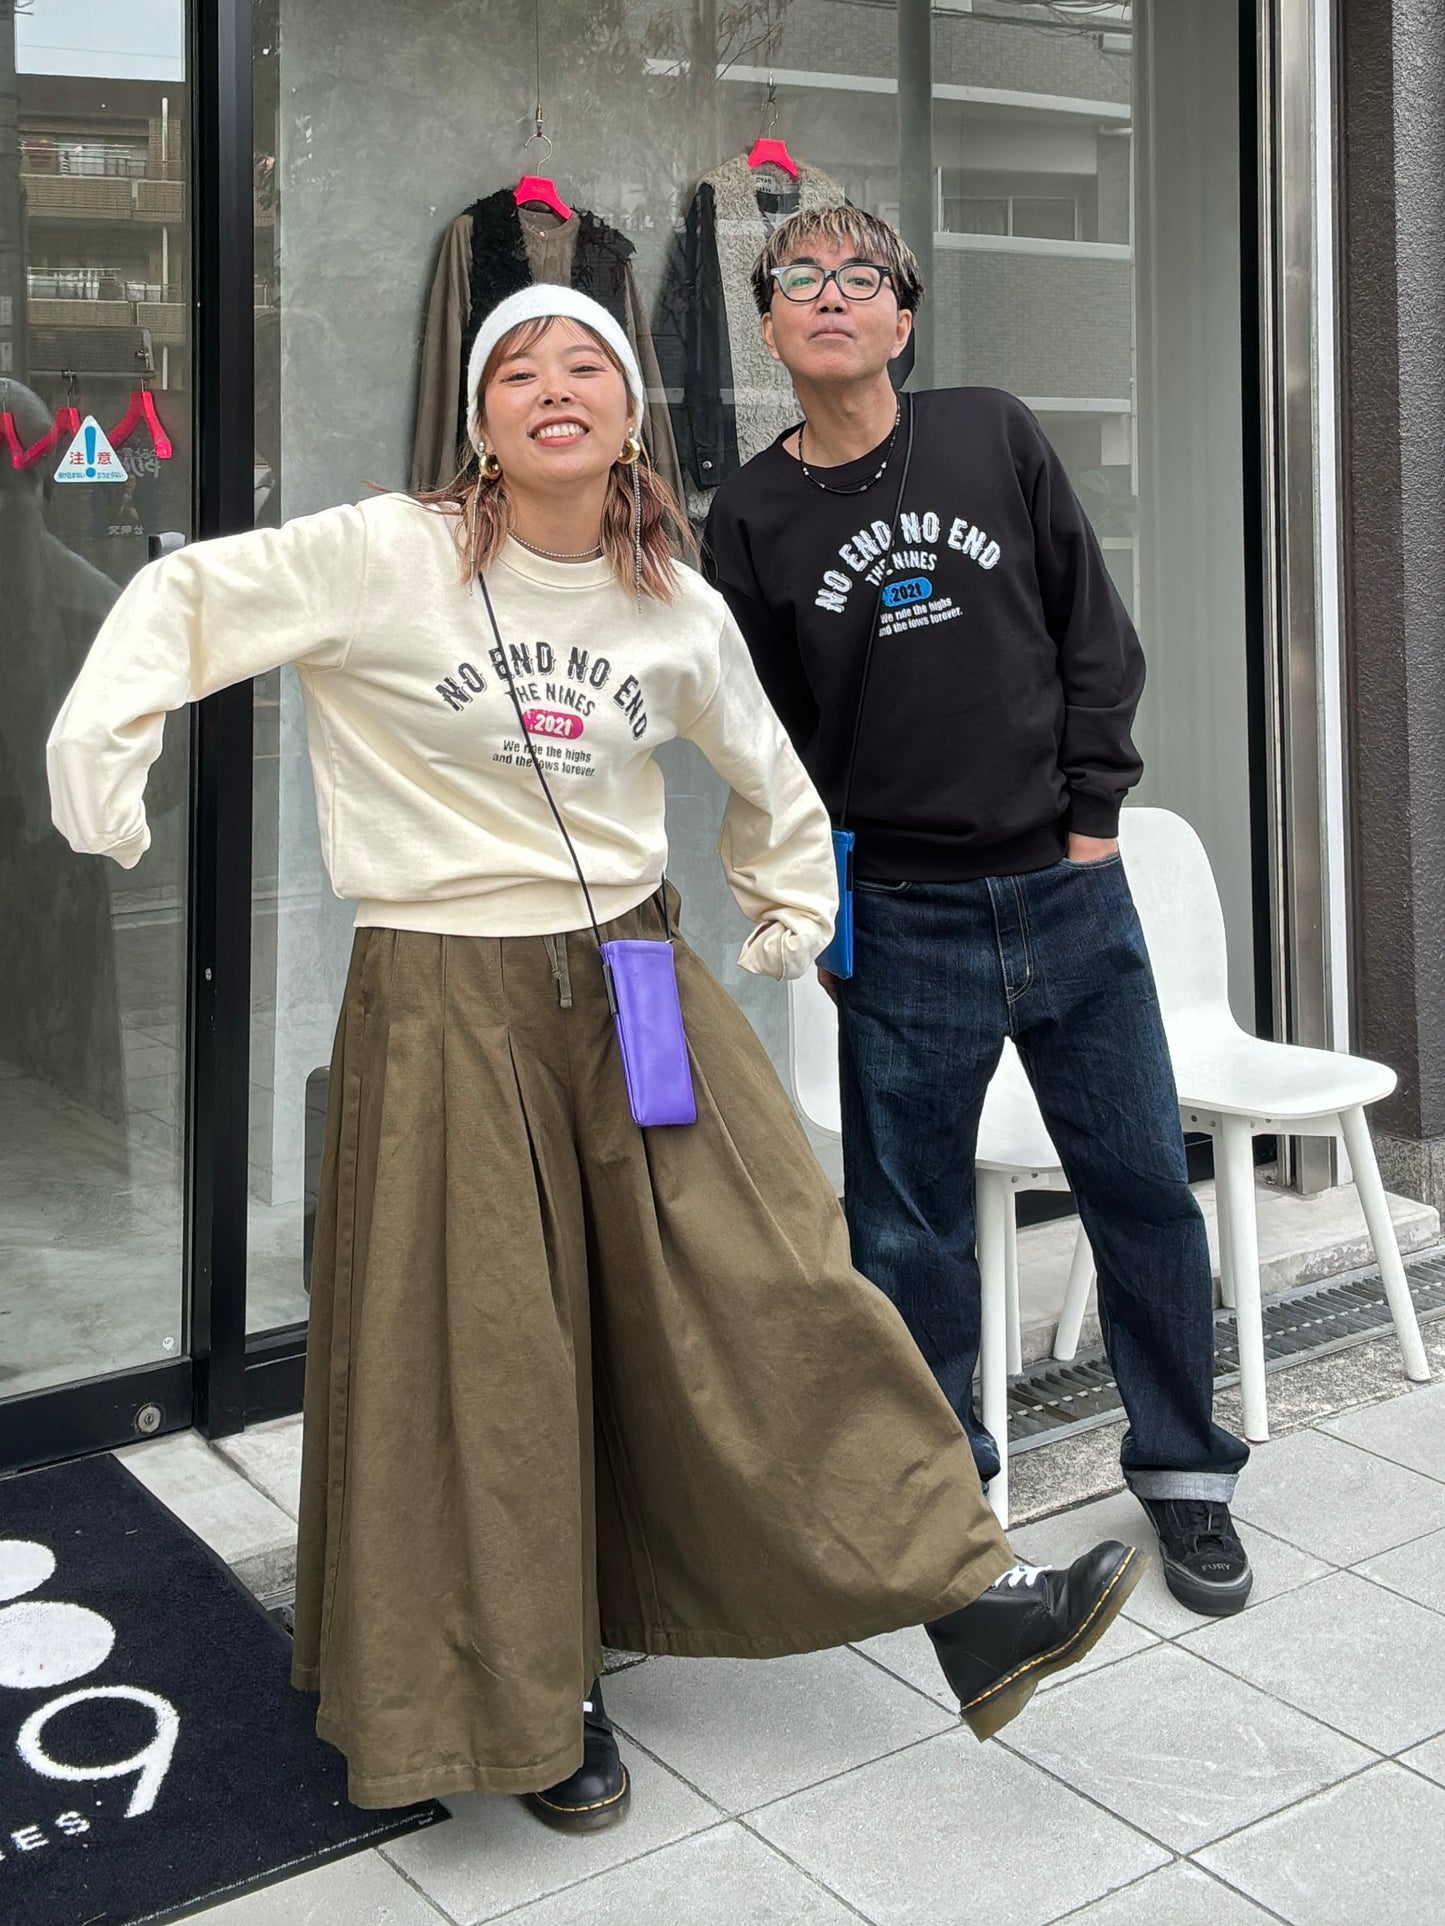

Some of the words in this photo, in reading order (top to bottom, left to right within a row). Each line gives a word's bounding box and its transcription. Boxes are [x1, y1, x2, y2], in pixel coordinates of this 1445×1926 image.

[814, 569, 853, 614] NO
[838, 520, 895, 573] END
[900, 511, 941, 544] NO
[947, 517, 1001, 570] END
[891, 550, 937, 571] NINES
[890, 582, 922, 602] 2021
[880, 612, 894, 624] We
[895, 608, 912, 620] ride
[912, 604, 928, 616] the
[928, 597, 952, 612] highs
[893, 621, 908, 633] the
[908, 616, 929, 629] lows
[929, 607, 964, 624] forever.
[435, 662, 487, 711] NO
[488, 642, 556, 680] END
[567, 646, 611, 690] NO
[613, 674, 648, 740] END
[546, 683, 596, 716] NINES
[533, 713, 574, 736] 2021
[492, 752, 512, 765] and
[515, 755, 533, 767] the
[503, 740, 520, 753] We
[523, 743, 544, 755] rde
[546, 745, 562, 758] the
[565, 748, 592, 763] highs
[1201, 1562, 1231, 1572] FURY
[16, 1685, 181, 1819] 9
[0, 1811, 91, 1861] ES
